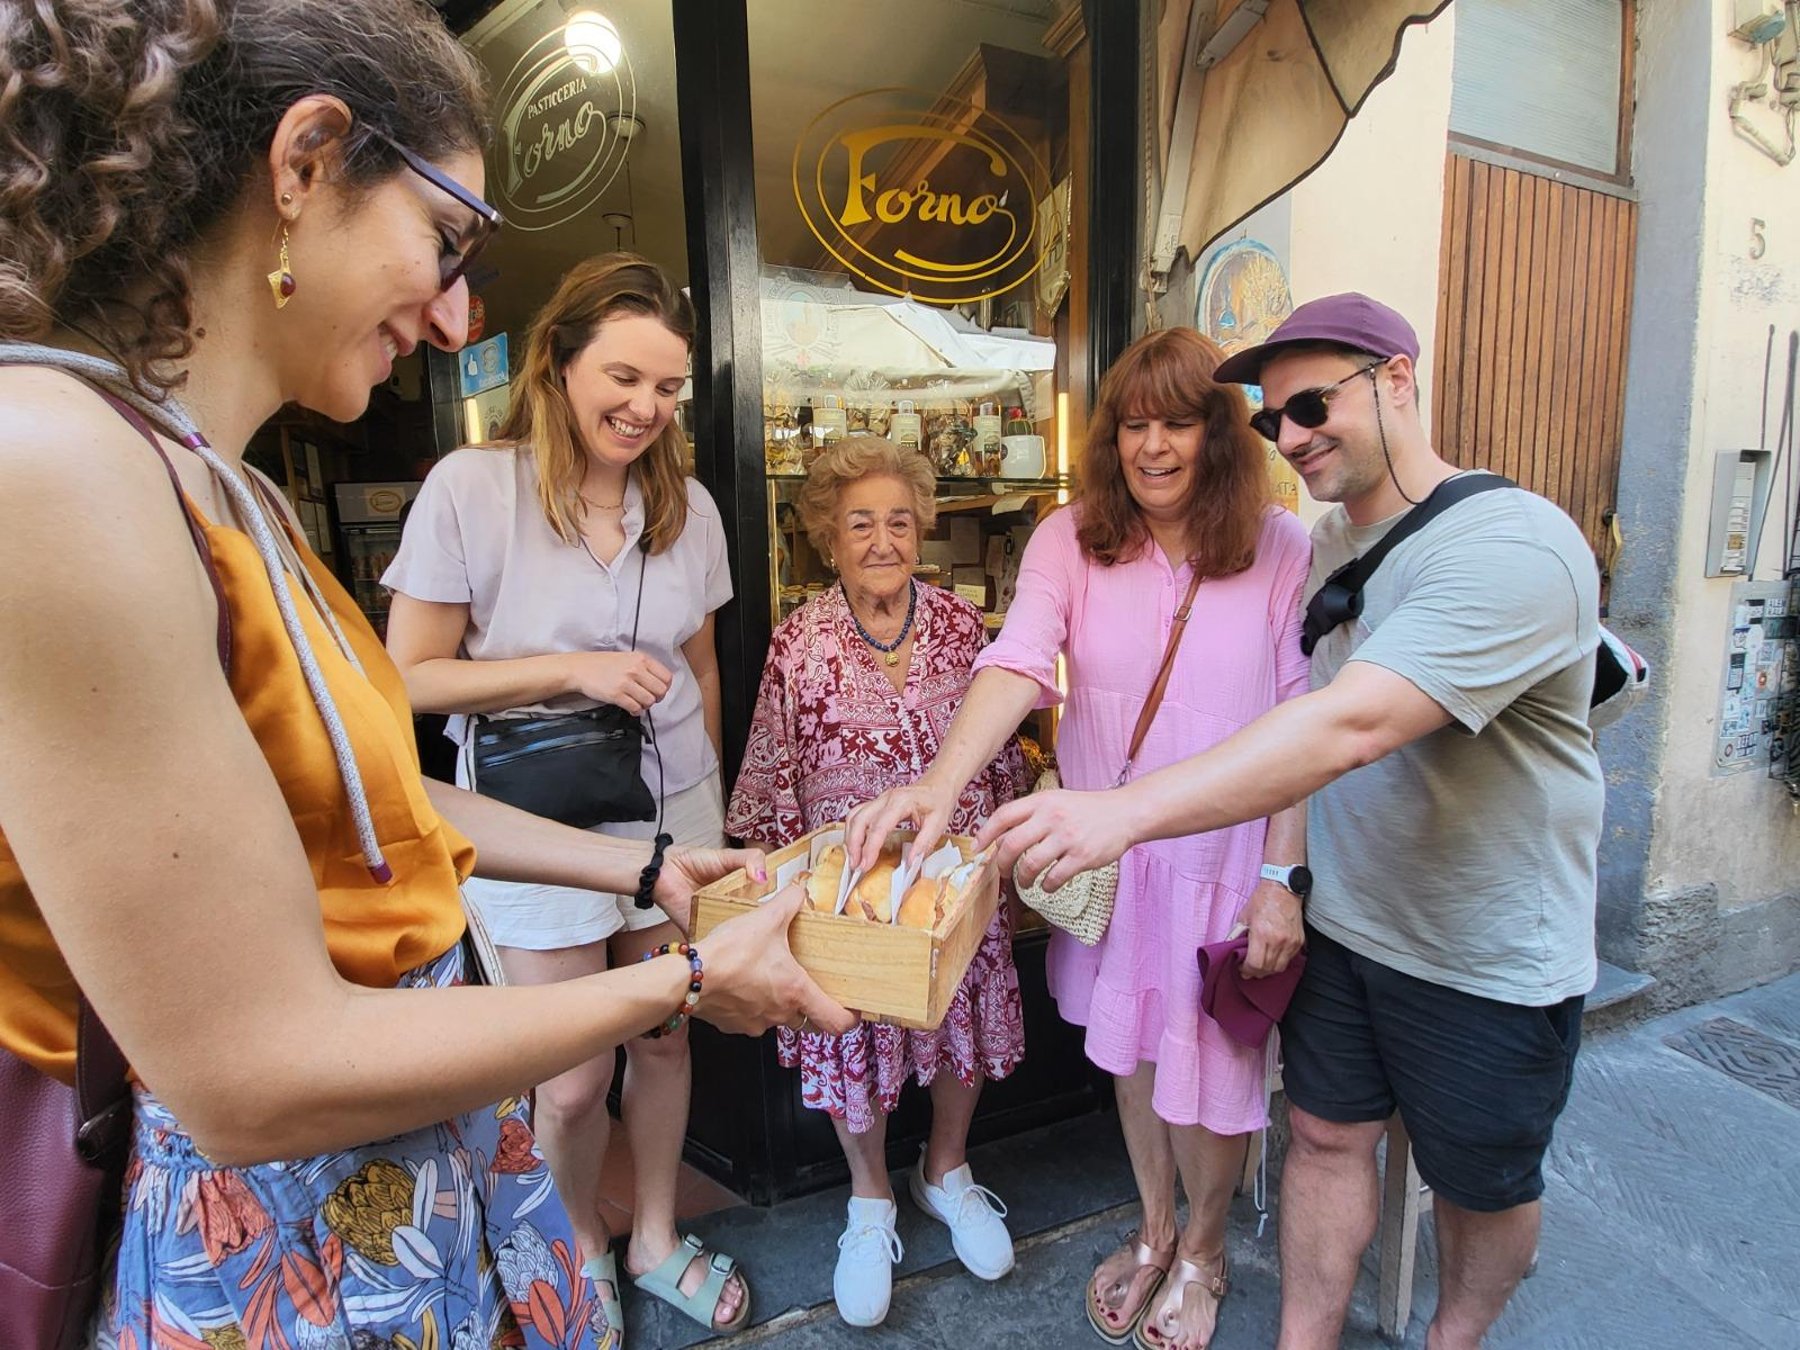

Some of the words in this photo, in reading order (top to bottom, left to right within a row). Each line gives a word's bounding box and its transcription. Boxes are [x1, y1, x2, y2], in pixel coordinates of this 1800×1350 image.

[503, 54, 607, 203] Forno
[527, 77, 588, 119] PASTICCERIA
[839, 125, 1016, 272] Forno
[1749, 217, 1766, 260] 5
